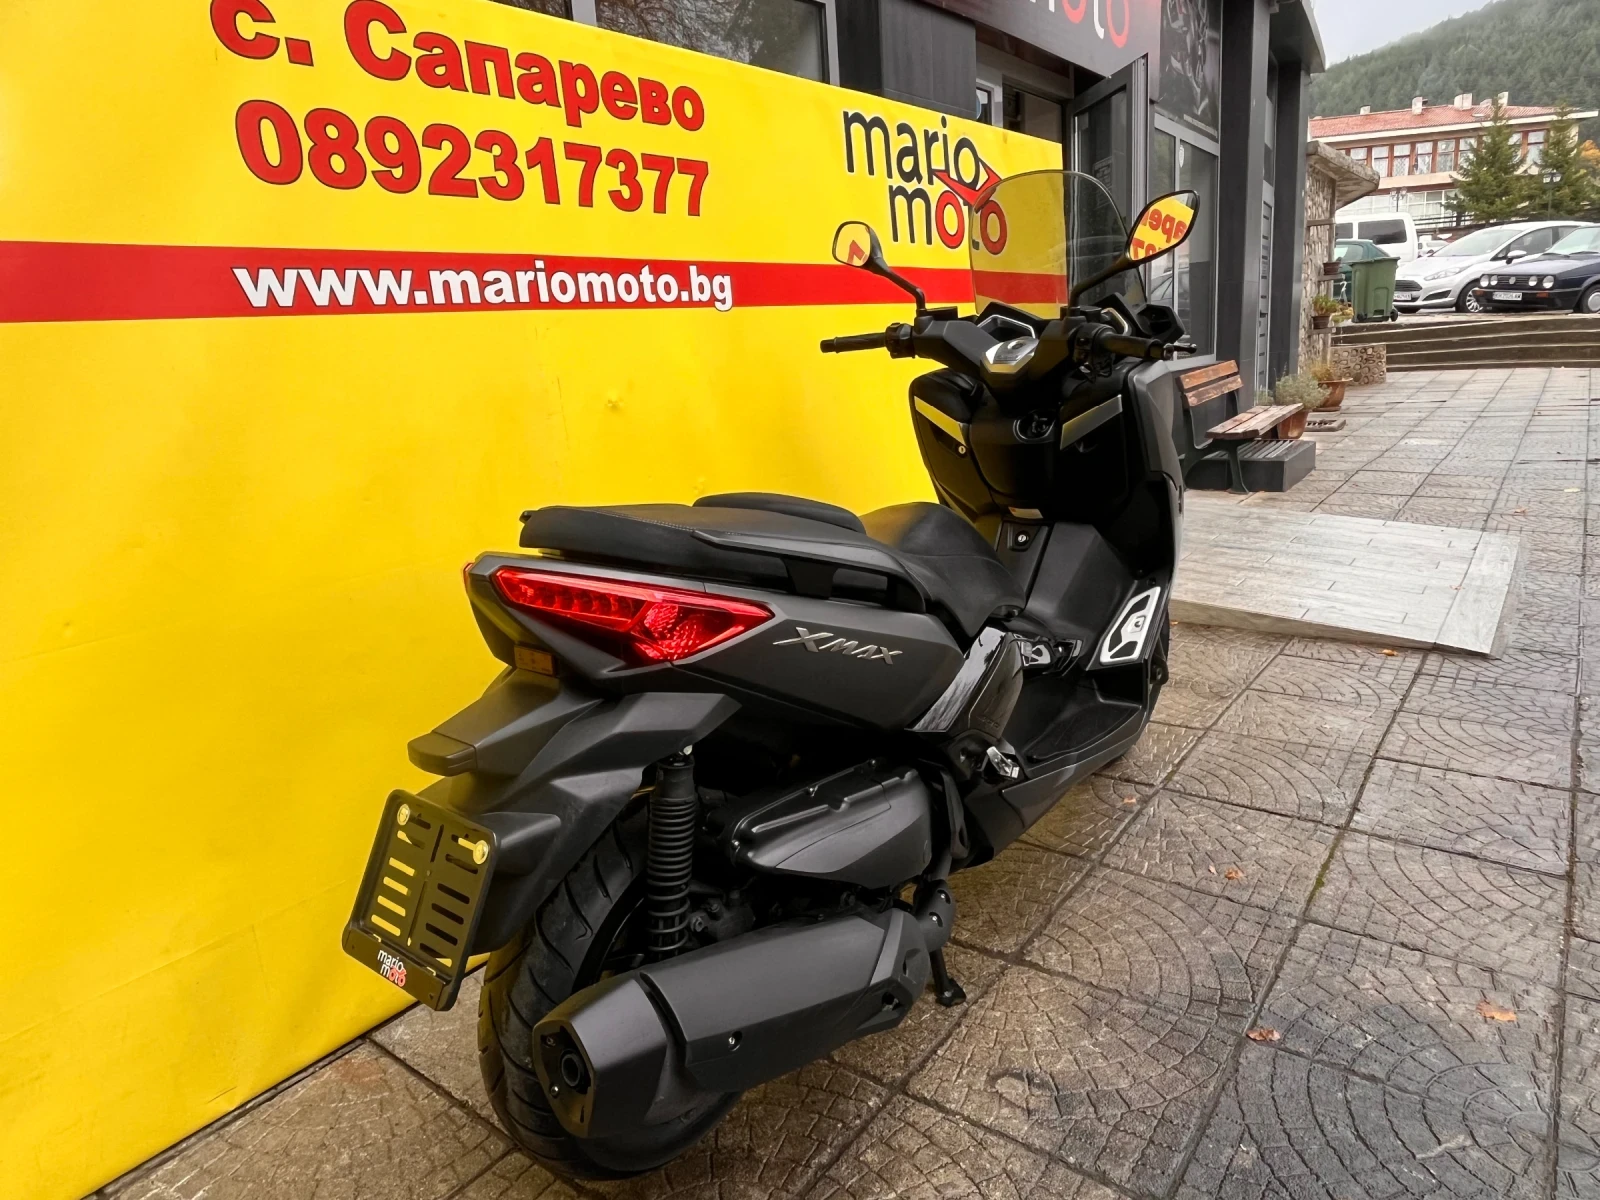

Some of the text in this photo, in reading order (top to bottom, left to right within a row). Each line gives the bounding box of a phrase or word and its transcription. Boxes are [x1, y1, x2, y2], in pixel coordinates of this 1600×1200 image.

[344, 0, 705, 132] Сапарево
[235, 99, 709, 217] 0892317377
[843, 111, 981, 190] mario
[231, 260, 733, 311] www.mariomoto.bg
[377, 950, 404, 972] mario
[380, 964, 406, 987] moto
